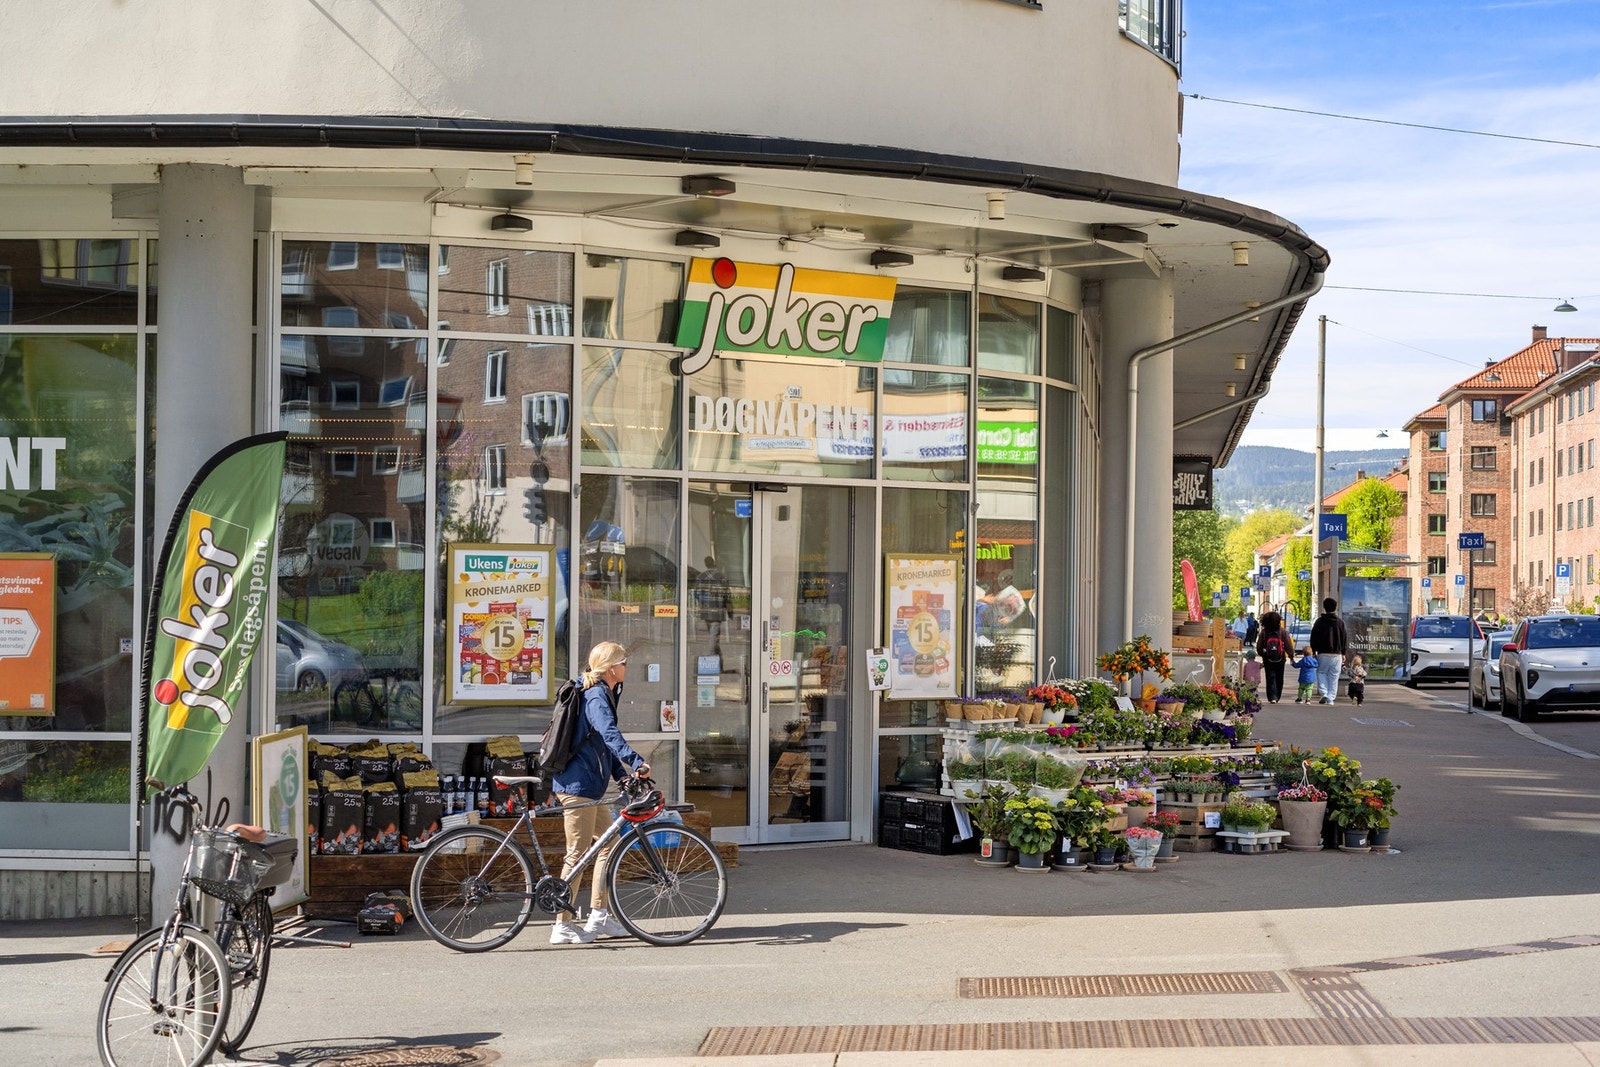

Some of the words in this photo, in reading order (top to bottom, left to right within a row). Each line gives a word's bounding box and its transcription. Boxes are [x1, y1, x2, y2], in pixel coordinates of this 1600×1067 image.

[680, 257, 879, 375] joker
[694, 393, 868, 442] DØGNÅPENT
[0, 436, 66, 490] NT
[1324, 523, 1343, 532] Taxi
[1460, 536, 1484, 546] Taxi
[469, 558, 504, 569] Ukens
[897, 569, 952, 581] KRONEMARKED
[1261, 566, 1269, 576] P
[1559, 565, 1567, 576] P
[1423, 579, 1430, 588] P
[1457, 575, 1464, 584] P
[465, 583, 542, 598] KRONEMARKED
[1242, 588, 1249, 597] P
[2, 617, 23, 625] TIPS:
[154, 528, 239, 725] joker
[489, 625, 516, 648] 15
[914, 622, 933, 643] 15
[1355, 633, 1371, 643] Nytt
[1379, 642, 1401, 651] havn.
[334, 762, 346, 771] 2,5
[372, 764, 384, 772] 2,5
[344, 798, 356, 807] 2,5
[382, 797, 394, 807] 2,5
[425, 795, 436, 804] 2,5
